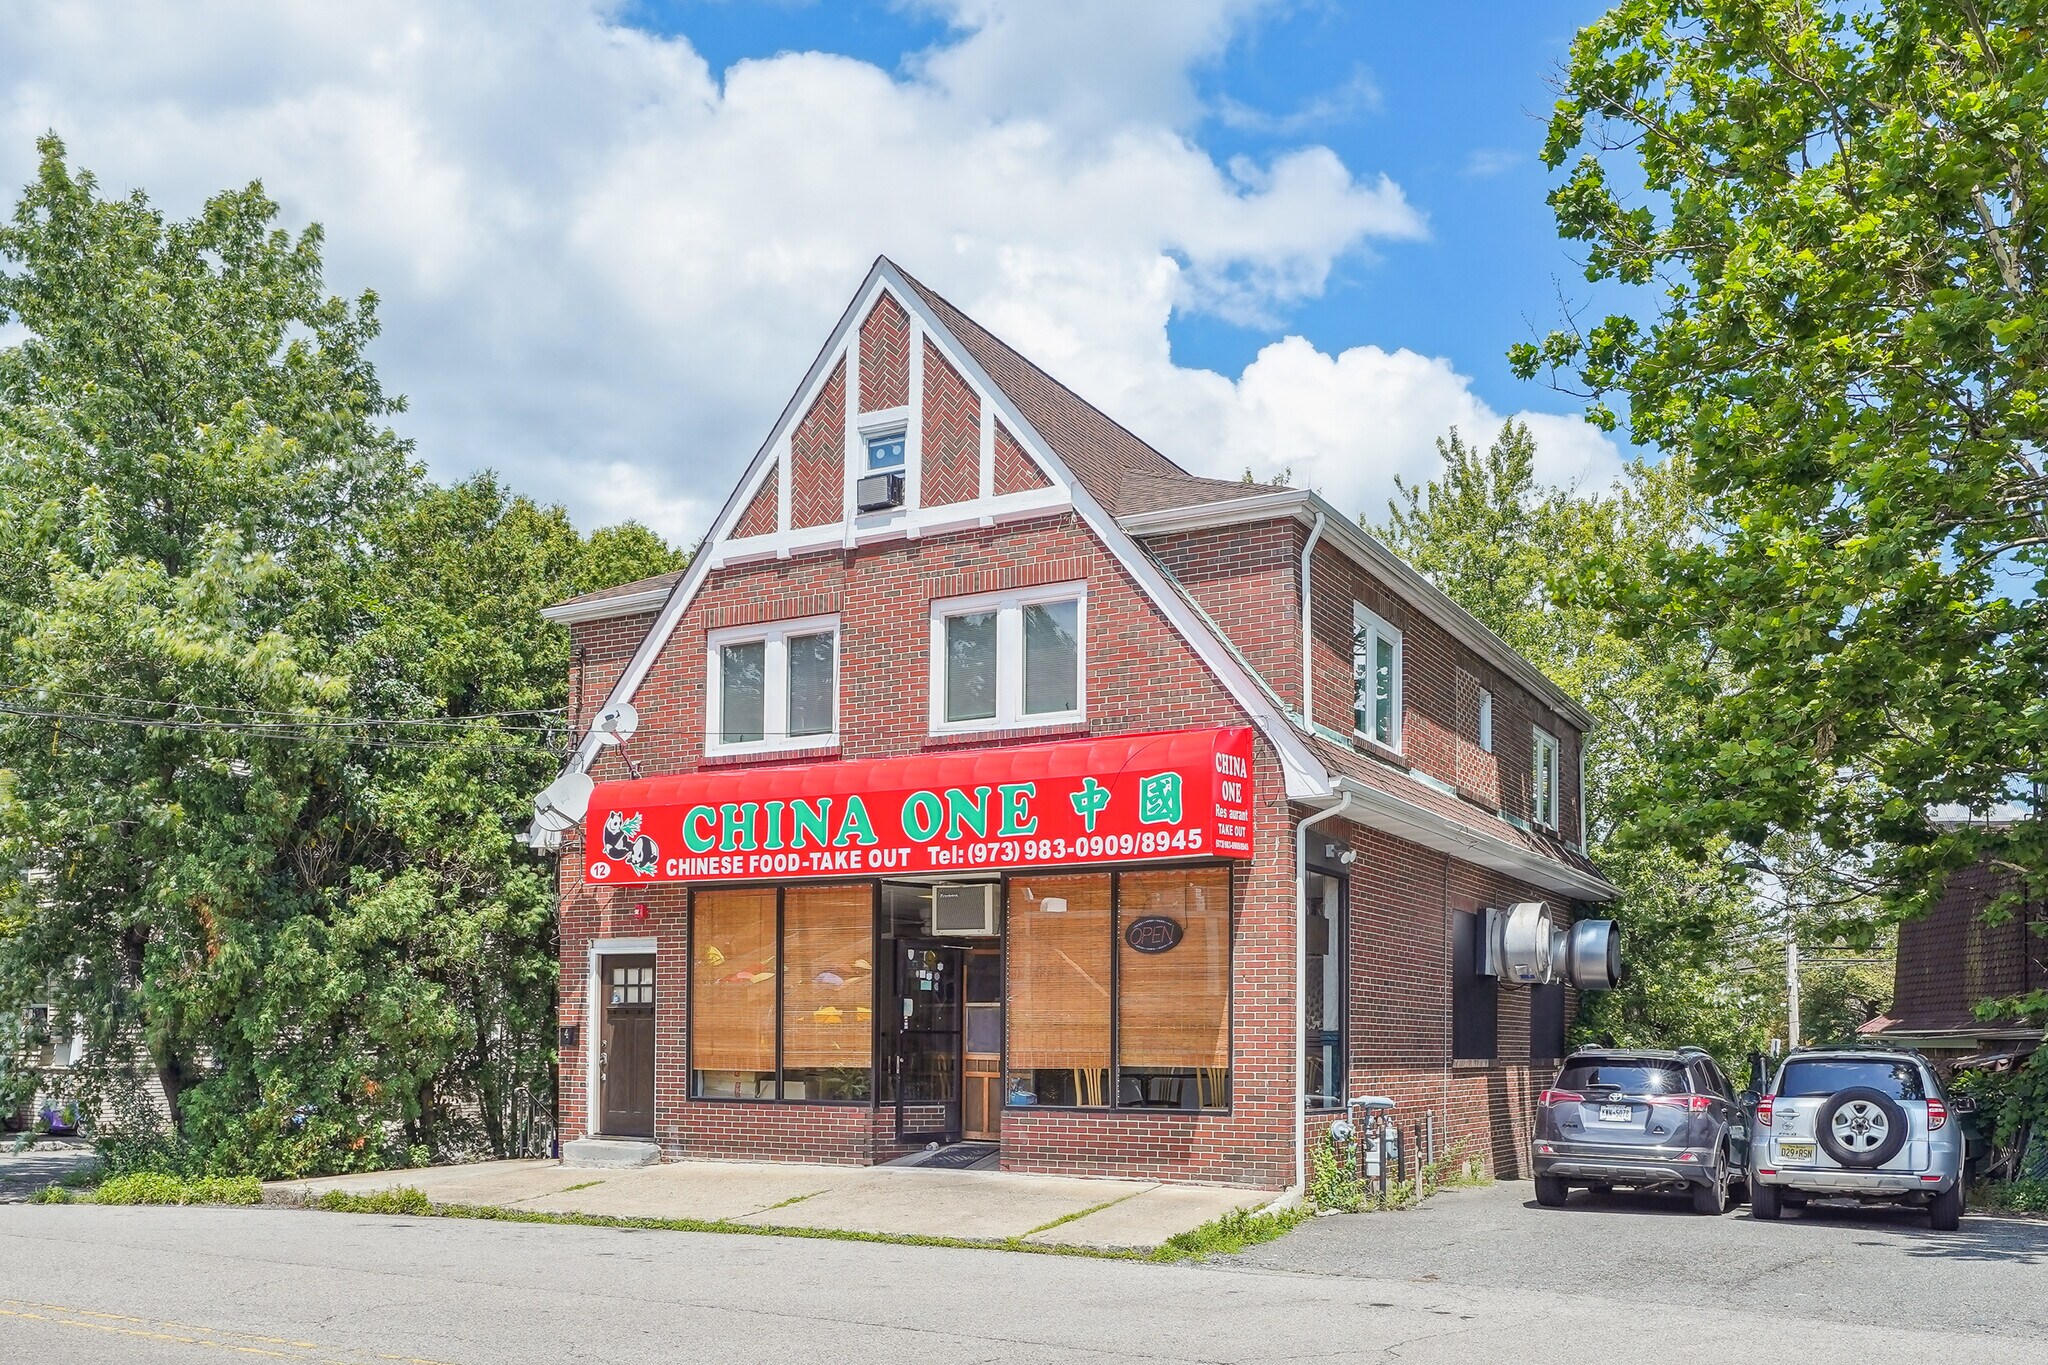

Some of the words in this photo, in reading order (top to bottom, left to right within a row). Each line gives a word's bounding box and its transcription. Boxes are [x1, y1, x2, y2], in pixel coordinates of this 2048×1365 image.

[1215, 752, 1247, 778] CHINA
[1221, 780, 1242, 803] ONE
[682, 795, 879, 853] CHINA
[901, 782, 1038, 842] ONE
[1218, 823, 1233, 836] TAKE
[1234, 825, 1246, 838] OUT
[666, 855, 744, 876] CHINESE
[868, 848, 911, 868] OUT
[1024, 828, 1202, 860] 983-0909/8945
[593, 864, 606, 877] 12
[1130, 925, 1175, 945] OPEN
